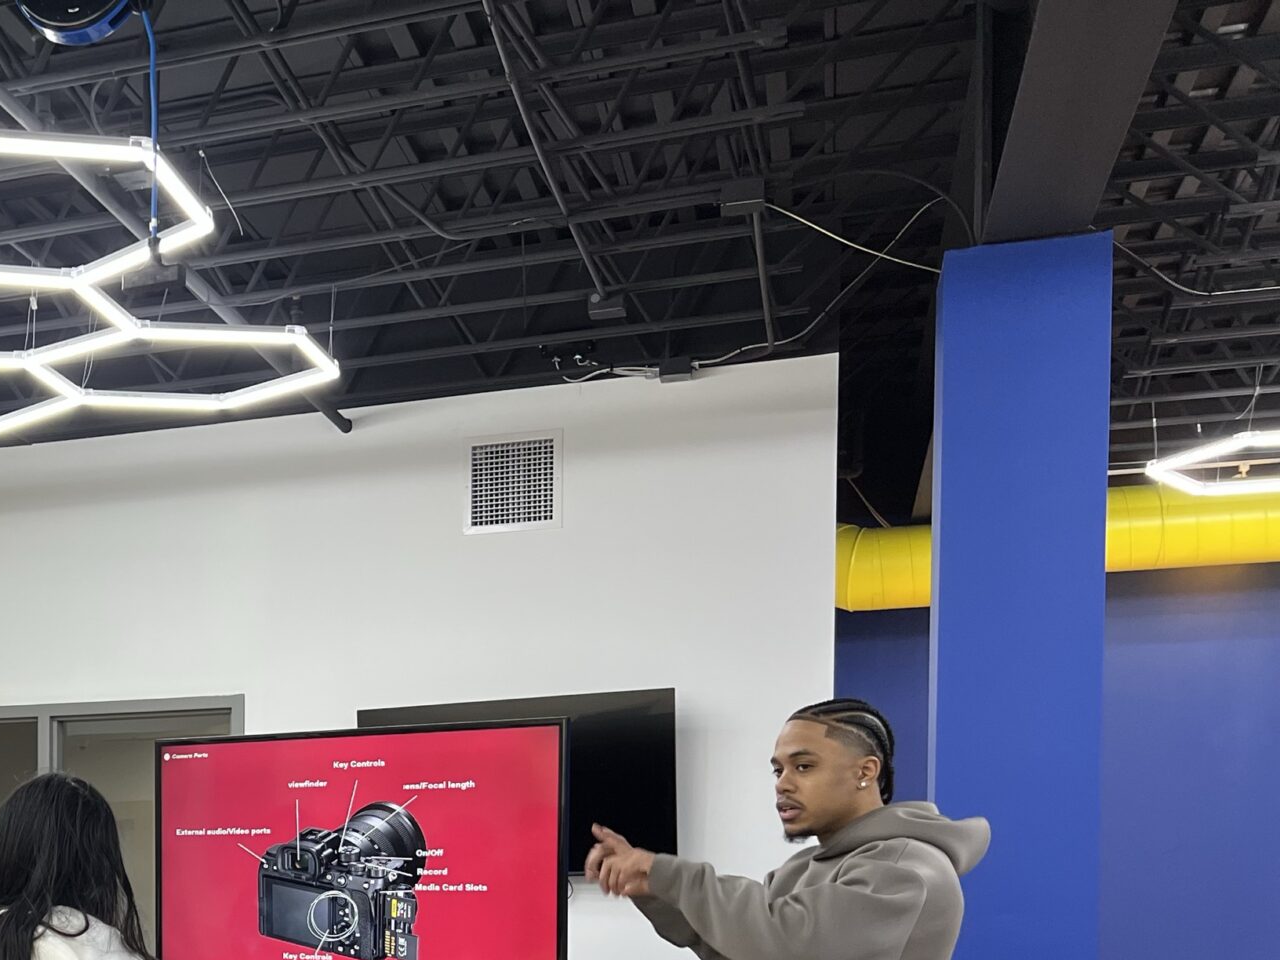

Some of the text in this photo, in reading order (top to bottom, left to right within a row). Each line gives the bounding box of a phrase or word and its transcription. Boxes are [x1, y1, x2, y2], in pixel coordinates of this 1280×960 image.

[333, 759, 385, 769] Key Controls
[288, 780, 327, 788] viewfinder
[447, 780, 476, 791] length
[176, 827, 271, 837] External audio/Video ports
[416, 849, 444, 857] On/Off
[417, 867, 448, 876] Record
[415, 883, 488, 892] Media Card Slots
[282, 952, 333, 960] Key Controls
